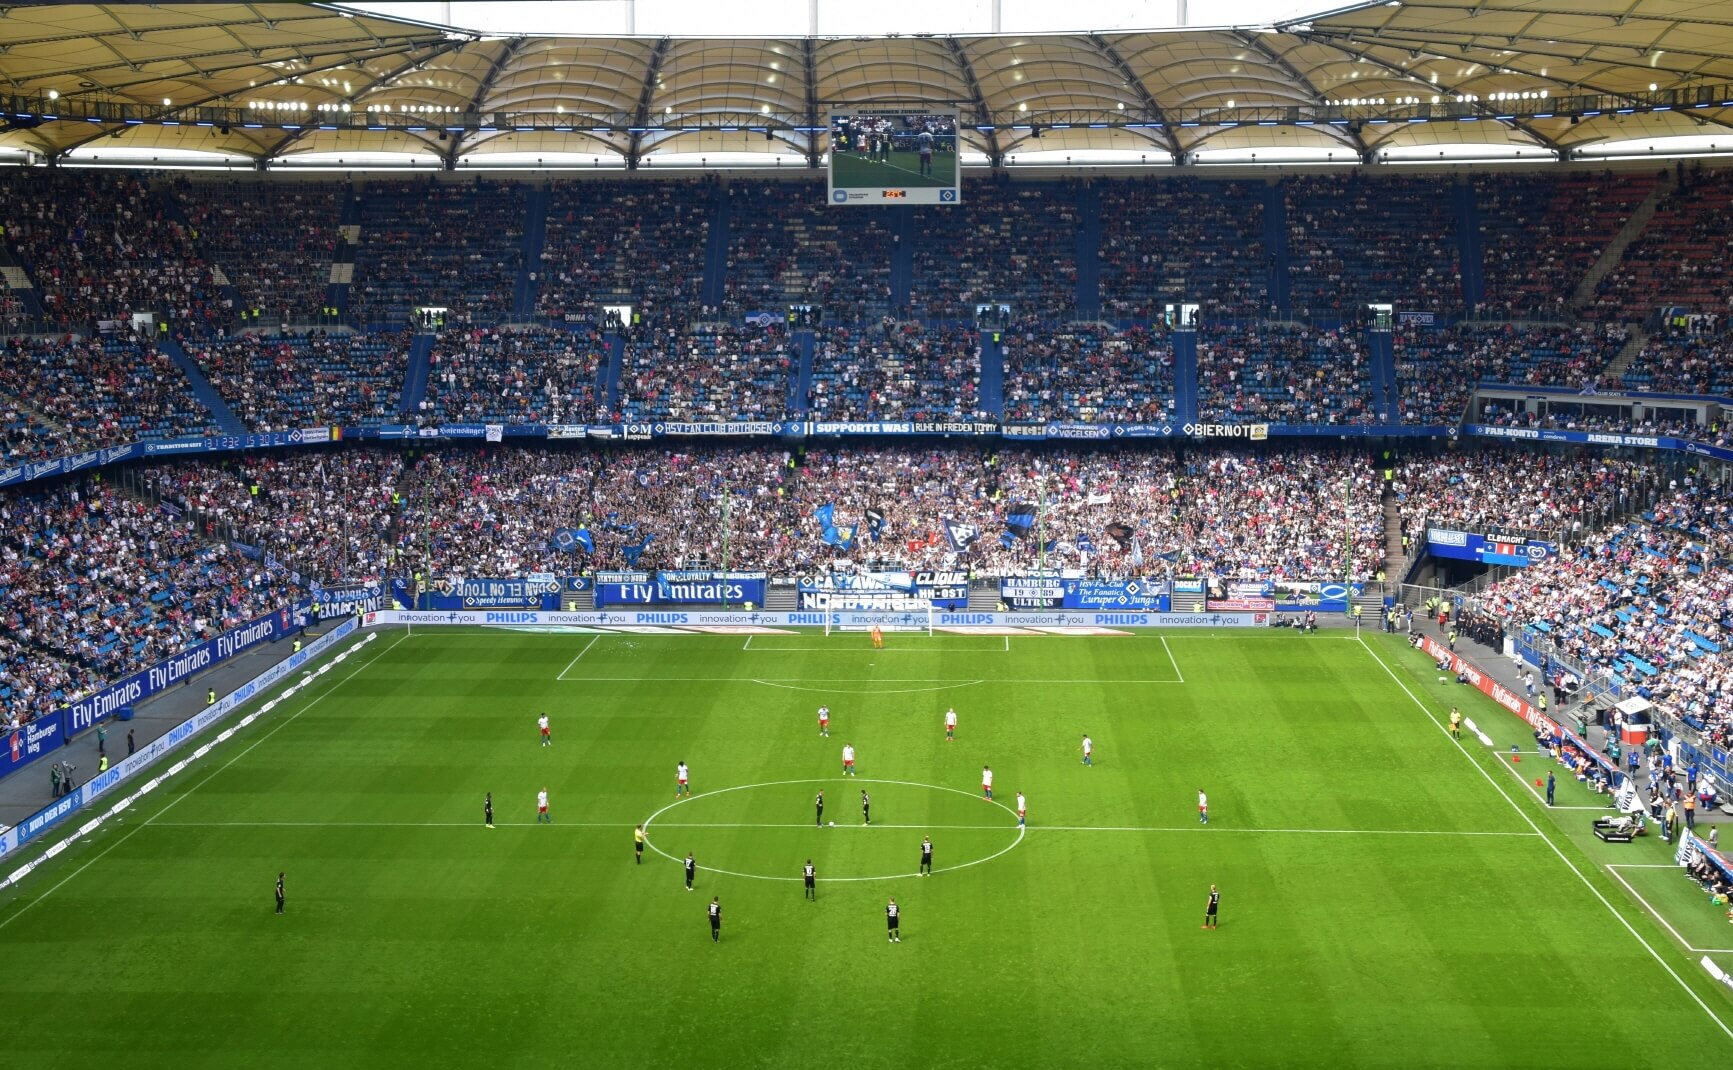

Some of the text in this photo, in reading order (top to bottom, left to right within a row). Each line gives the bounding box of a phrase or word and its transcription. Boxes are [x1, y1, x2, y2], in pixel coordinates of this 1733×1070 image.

[665, 424, 682, 433] HSV
[684, 424, 701, 433] FAN
[704, 424, 726, 433] CLUB
[816, 423, 910, 433] SUPPORTE WAS
[915, 423, 935, 432] RUHE
[943, 423, 973, 432] FRIEDEN
[974, 423, 997, 432] TOMMY
[1194, 423, 1250, 437] BIERNOT
[1485, 427, 1539, 438] FAN-KONTO
[1587, 434, 1658, 446] ARENA STORE
[1007, 579, 1060, 588] HAMBURG
[318, 595, 383, 619] EXMACHINE
[1013, 598, 1054, 607] ULTRAS
[486, 613, 538, 623] PHILIPS
[549, 613, 596, 623] innovation
[636, 613, 688, 623] PHILIPS
[699, 614, 747, 623] innovation
[788, 613, 840, 624] PHILIS
[941, 614, 994, 624] PHILIPS
[1005, 614, 1053, 624] innovation
[1095, 614, 1148, 624] PHILIPS
[1159, 615, 1208, 624] innovation
[217, 619, 273, 657] Fly Emirates
[149, 647, 210, 690] Fly Emirates
[72, 680, 141, 729] Fly Emirates
[27, 723, 37, 734] Der
[27, 723, 57, 743] Hamburger
[168, 721, 194, 746] PHILIPS
[27, 741, 40, 754] Weg
[91, 767, 120, 796] PHILIPS
[29, 817, 44, 833] NUR
[44, 806, 58, 823] DER
